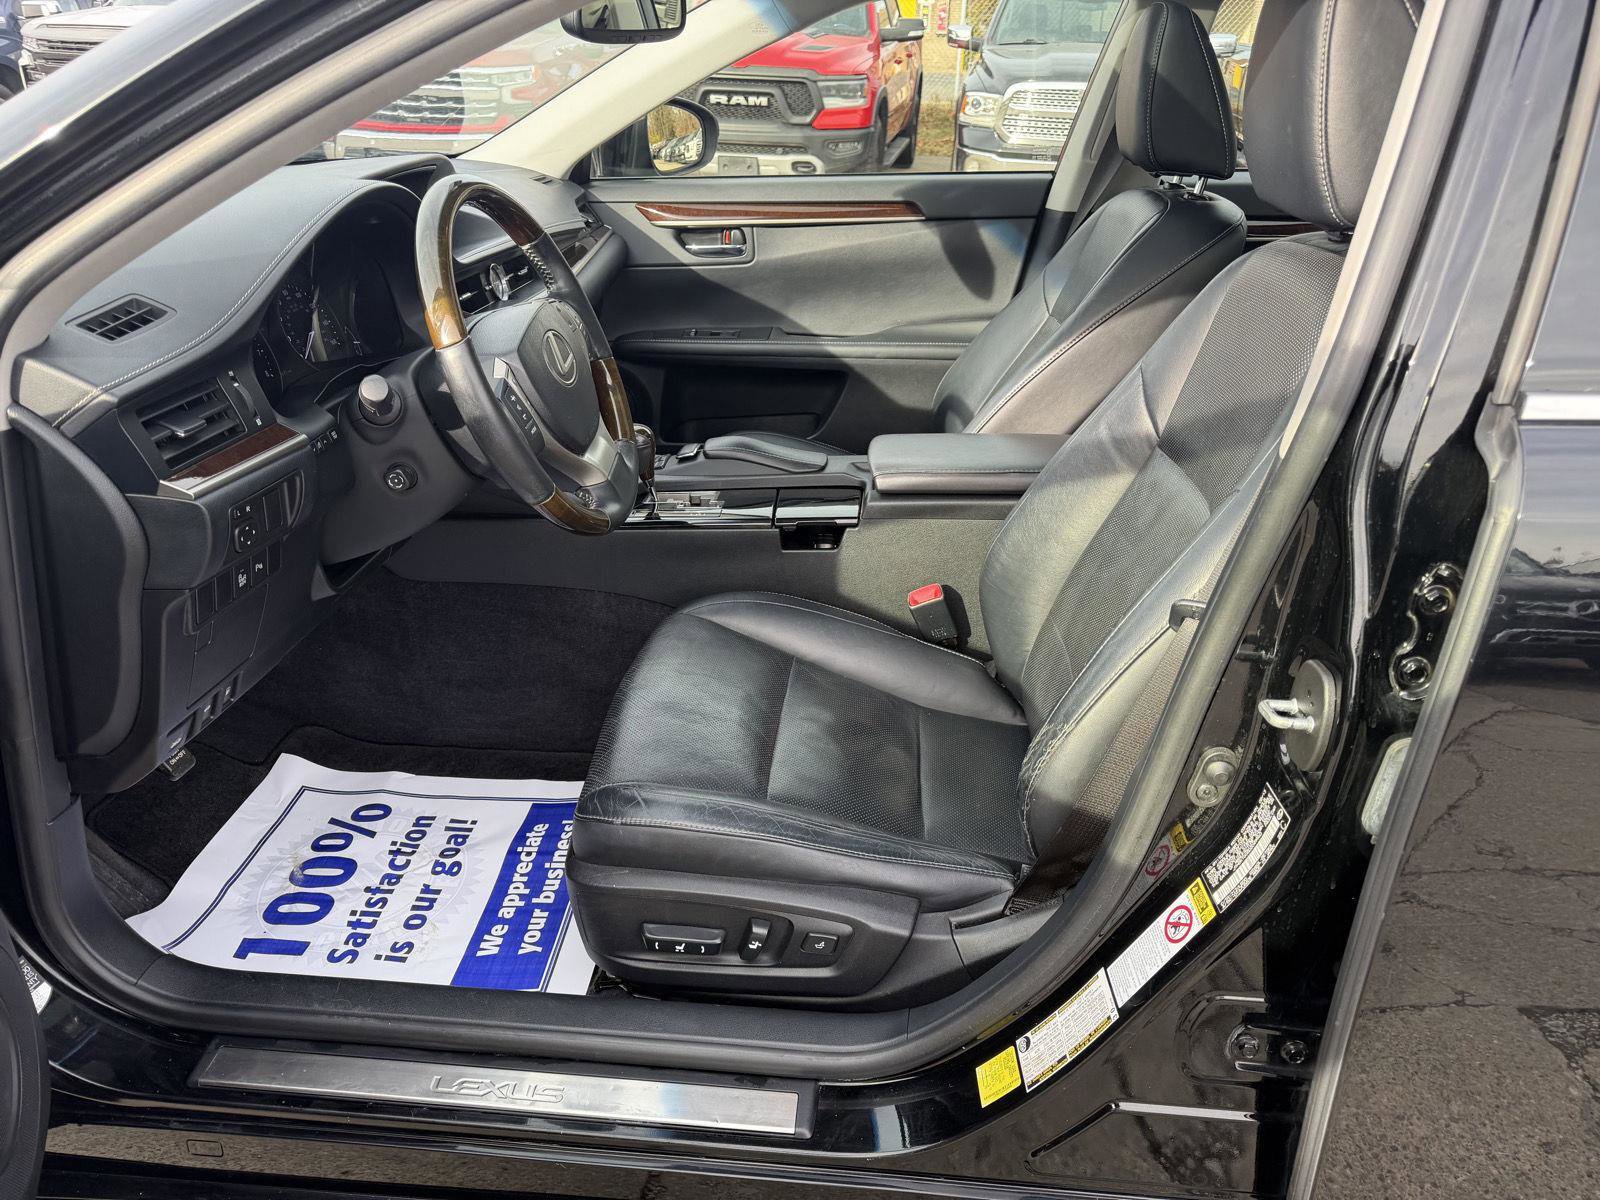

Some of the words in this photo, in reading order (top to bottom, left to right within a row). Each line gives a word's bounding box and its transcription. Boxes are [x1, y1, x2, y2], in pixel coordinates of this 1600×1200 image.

[709, 94, 769, 106] RAM
[233, 803, 392, 960] 100%
[327, 815, 437, 964] Satisfaction
[374, 941, 414, 963] is
[403, 884, 442, 930] our
[431, 818, 478, 877] goal!
[476, 924, 508, 957] We
[498, 823, 549, 919] appreciate
[518, 908, 549, 955] your
[430, 1075, 564, 1103] LEXUS
